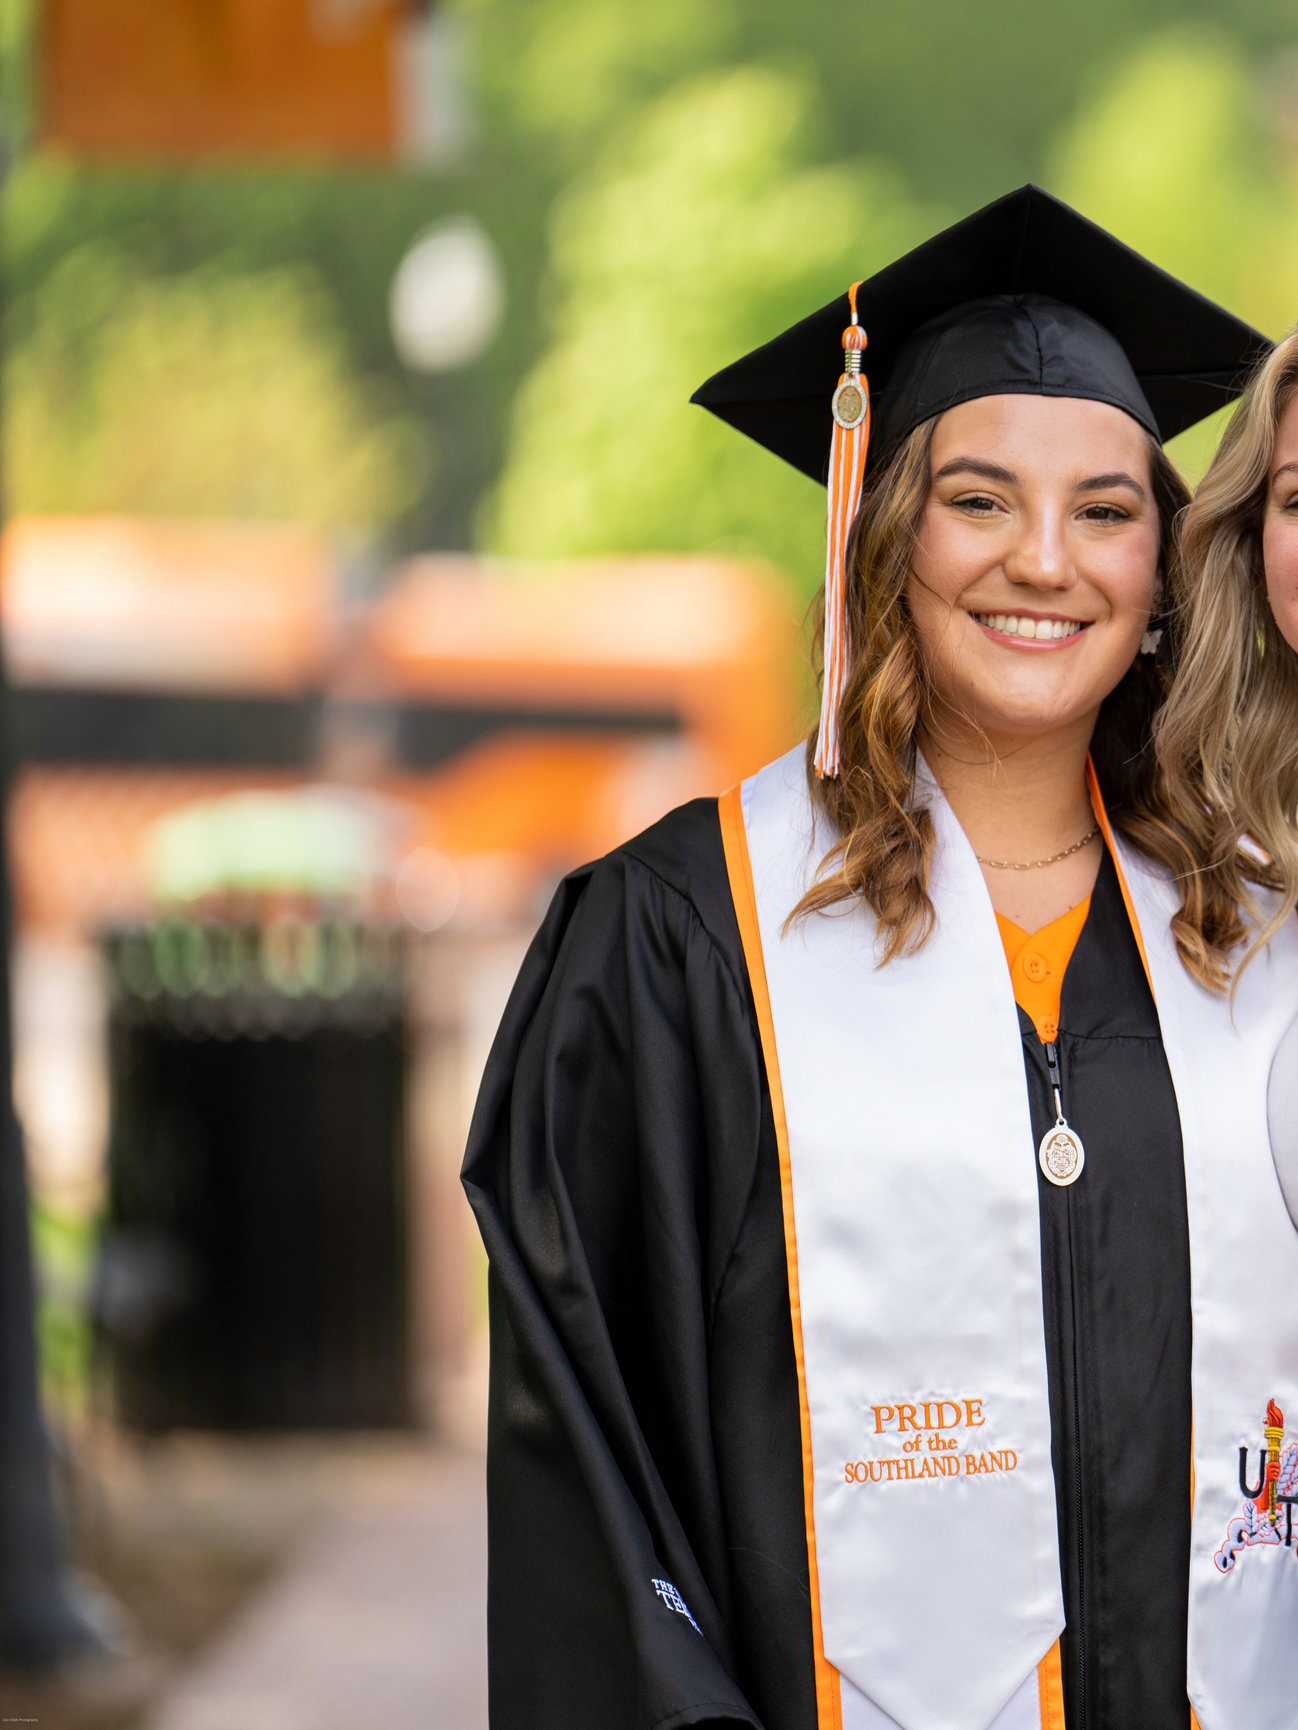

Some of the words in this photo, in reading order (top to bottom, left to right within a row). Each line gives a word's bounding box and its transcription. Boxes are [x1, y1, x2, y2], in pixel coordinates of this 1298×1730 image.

[870, 1398, 986, 1434] PRIDE
[902, 1432, 922, 1453] of
[927, 1432, 958, 1451] the
[844, 1455, 961, 1484] SOUTHLAND
[964, 1449, 1018, 1475] BAND
